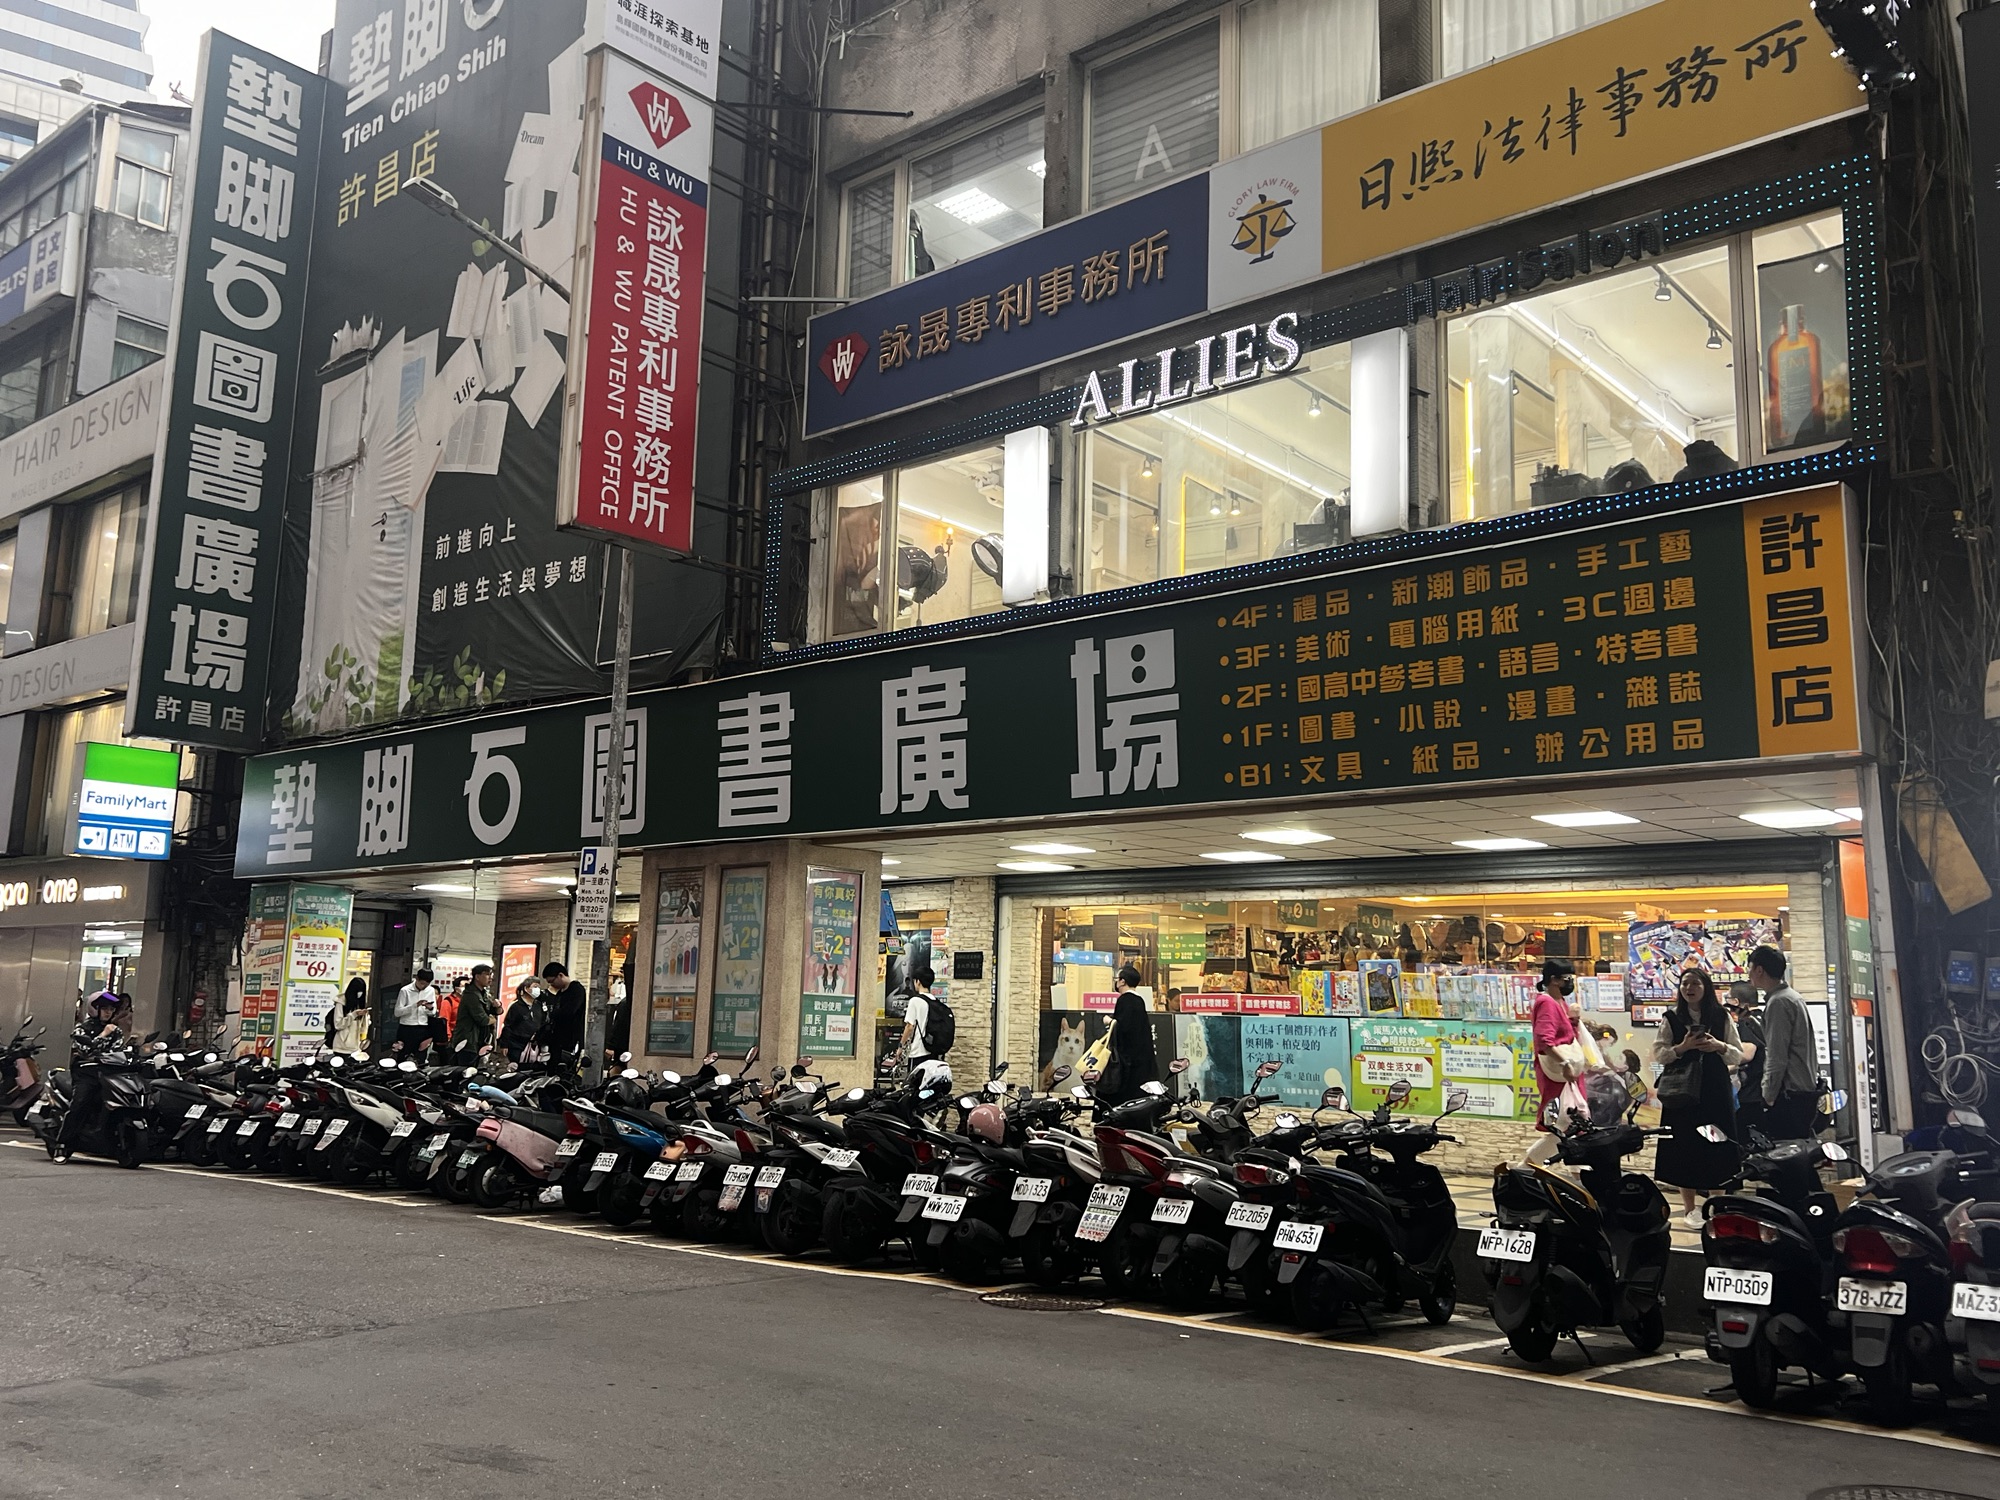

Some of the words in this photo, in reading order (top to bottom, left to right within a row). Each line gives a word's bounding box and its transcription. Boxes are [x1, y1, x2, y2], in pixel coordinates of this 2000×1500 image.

[342, 114, 384, 154] Tien
[390, 73, 450, 124] Chiao
[456, 35, 507, 83] Shih
[520, 130, 545, 146] Dream
[337, 128, 440, 228] 許昌店
[617, 146, 643, 170] HU
[647, 162, 660, 181] &
[665, 168, 693, 195] WU
[620, 185, 638, 226] HU
[1228, 186, 1254, 219] GLORY
[1256, 177, 1279, 190] LAW
[1279, 178, 1301, 197] FIRM
[617, 235, 635, 254] &
[613, 270, 633, 313] WU
[1405, 264, 1499, 324] Hair
[1518, 222, 1661, 291] Salon
[878, 228, 1169, 374] 詠晟專利事務所
[606, 321, 630, 420] PATENT
[629, 197, 685, 533] 詠晟專利事務所
[1069, 312, 1302, 428] ALLIES
[453, 376, 476, 405] Life
[13, 427, 60, 477] HAIR
[70, 380, 153, 450] DESIGN
[600, 430, 623, 519] OFFICE
[435, 517, 516, 560] 前進向上
[431, 555, 587, 613] 創造生活與夢想
[1759, 511, 1834, 729] 許昌店
[10, 657, 76, 702] DESIGN
[155, 695, 245, 733] 許昌店
[86, 791, 168, 810] FamilyMart
[112, 832, 134, 849] ATM
[583, 853, 594, 872] P
[813, 884, 856, 902] 有你真好
[833, 934, 844, 955] 2
[307, 960, 327, 978] 69
[303, 1012, 320, 1027] 75
[814, 1000, 842, 1012] 歡迎使用
[828, 1024, 849, 1033] Taiwan
[1228, 1207, 1269, 1224] PCG-2059
[1276, 1228, 1319, 1246] PHQ-6531
[1480, 1235, 1532, 1255] NFP-1628
[1707, 1276, 1769, 1296] NTP-0309
[1840, 1289, 1904, 1309] 378-JZZ
